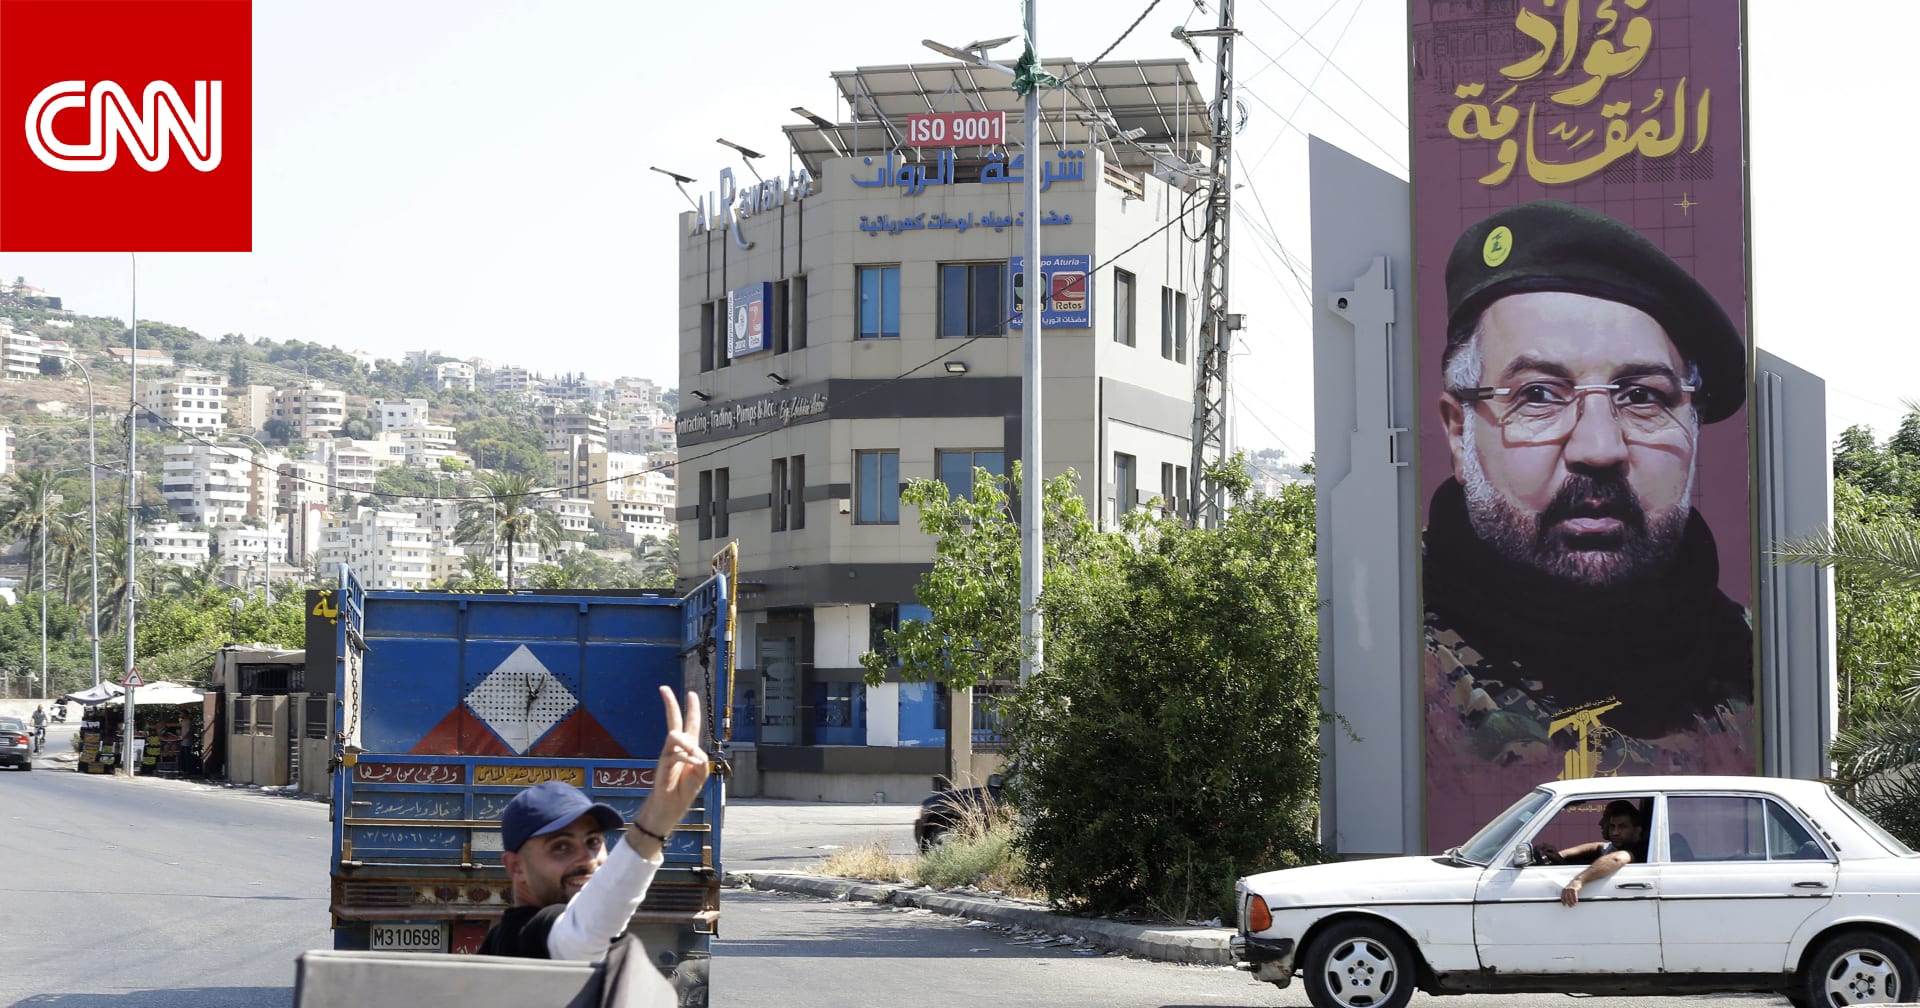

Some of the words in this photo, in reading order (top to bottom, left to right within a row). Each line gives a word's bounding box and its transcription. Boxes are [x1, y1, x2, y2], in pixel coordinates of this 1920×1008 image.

[1499, 0, 1653, 106] فؤاد
[910, 118, 945, 141] ISO
[952, 117, 1000, 140] 9001
[851, 150, 954, 196] الروان
[981, 150, 1085, 192] شركة
[927, 211, 973, 234] لوحات
[981, 210, 1012, 232] مياه
[1053, 258, 1080, 266] Aturia
[1055, 301, 1082, 310] Rotos
[676, 412, 707, 435] ontracting
[711, 408, 733, 430] Trading
[736, 404, 756, 426] Pumps
[374, 928, 440, 946] M310698
